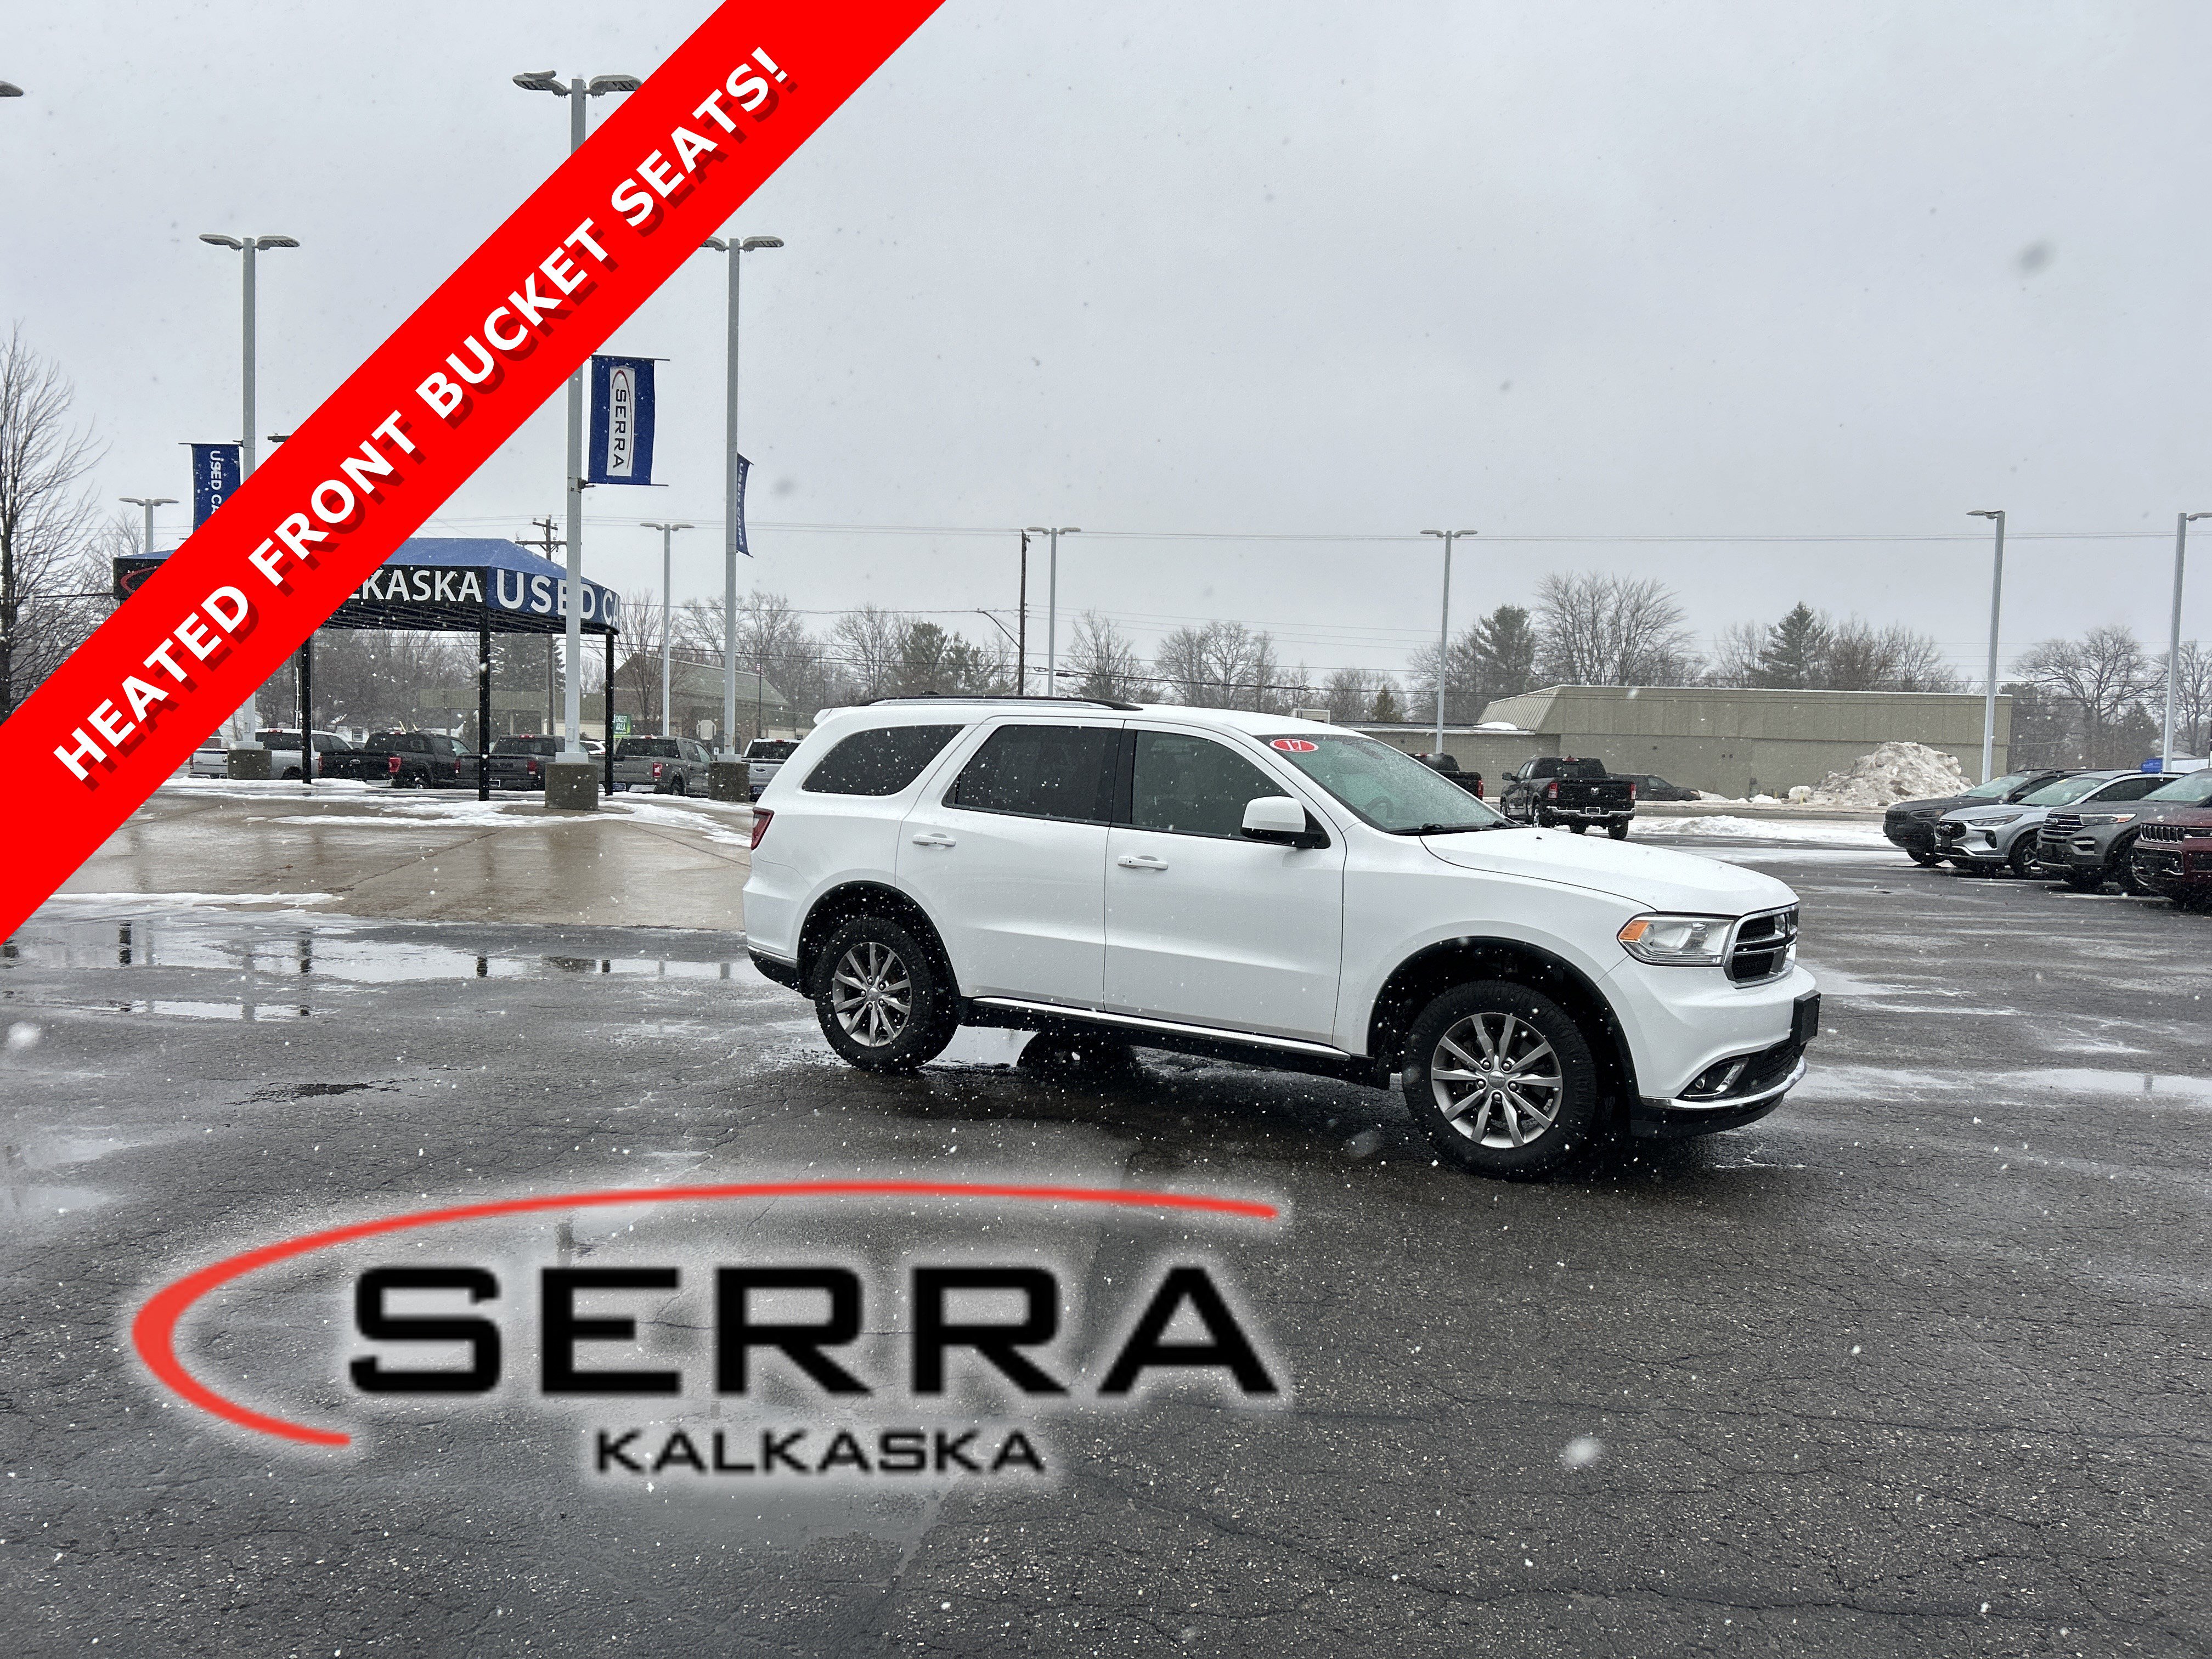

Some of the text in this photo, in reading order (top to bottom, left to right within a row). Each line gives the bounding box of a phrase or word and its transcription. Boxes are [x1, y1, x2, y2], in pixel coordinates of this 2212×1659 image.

[613, 388, 627, 469] SERRA
[210, 450, 222, 490] USED
[1283, 740, 1302, 751] 17
